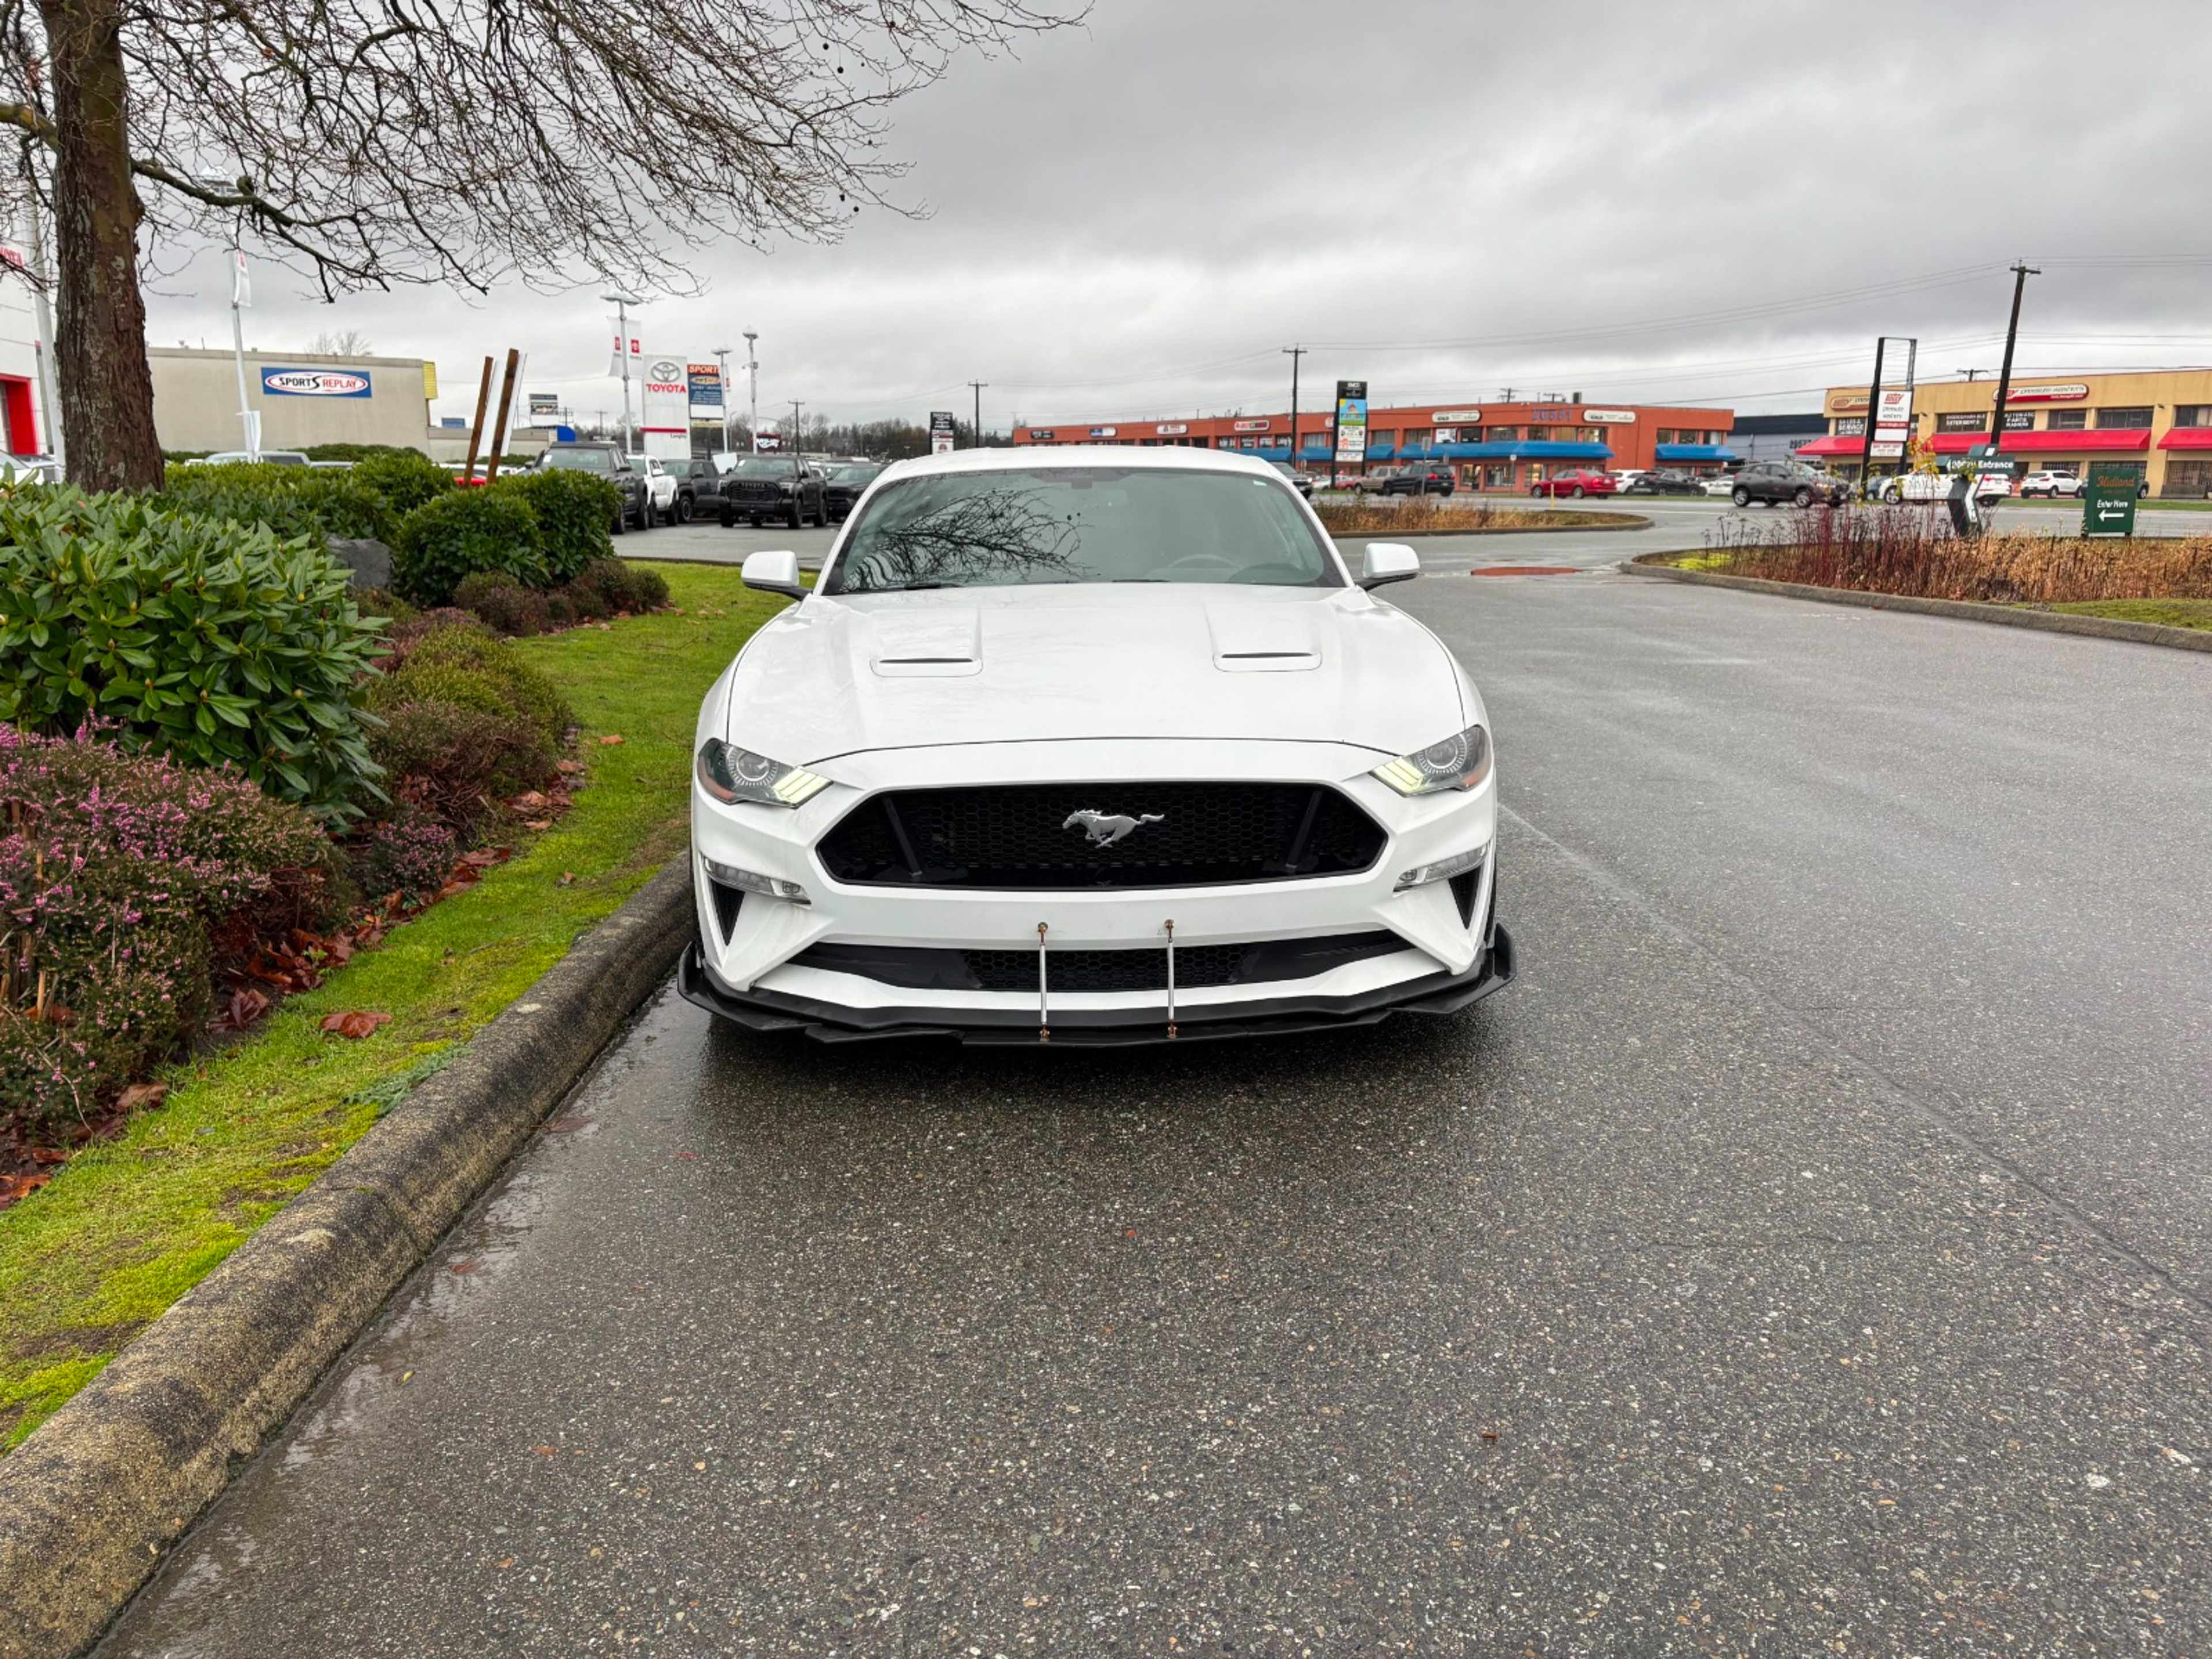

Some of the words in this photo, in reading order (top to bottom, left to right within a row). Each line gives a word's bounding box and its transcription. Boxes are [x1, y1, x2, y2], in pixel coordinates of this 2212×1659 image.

[279, 376, 320, 390] SPORTS
[322, 378, 357, 389] REPLAY
[646, 384, 686, 392] TOYOTA
[1978, 460, 2014, 469] Entrance
